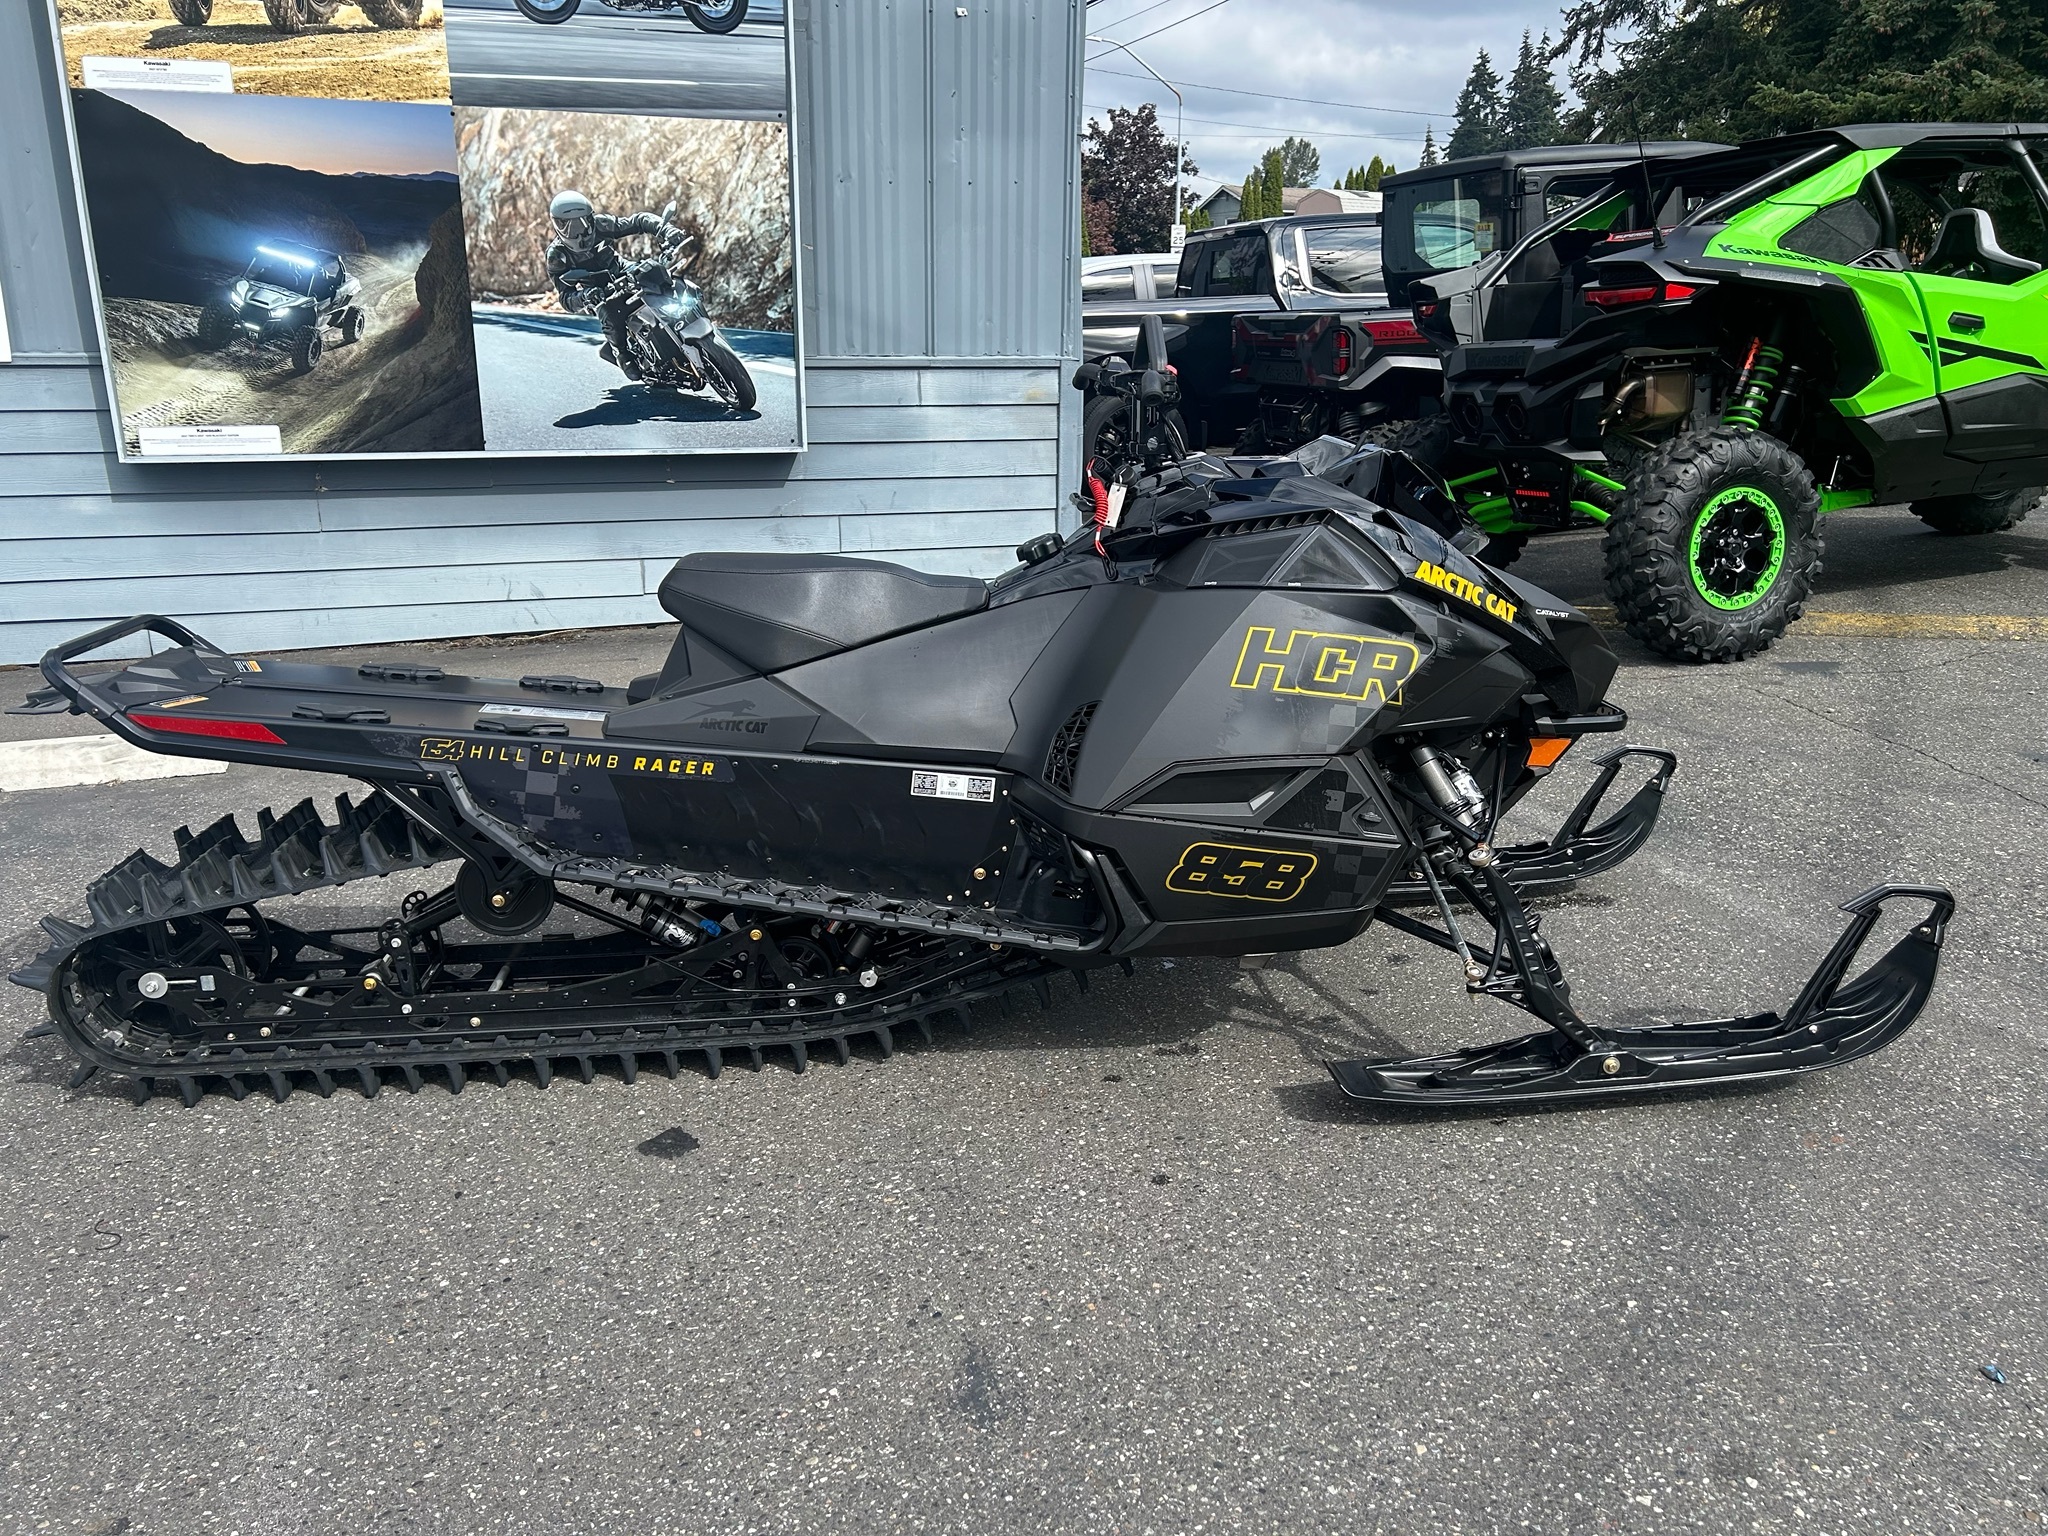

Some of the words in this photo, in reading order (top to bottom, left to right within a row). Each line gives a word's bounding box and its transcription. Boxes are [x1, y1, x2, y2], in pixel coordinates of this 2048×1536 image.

[1173, 236, 1184, 245] 25
[1717, 243, 1829, 267] Kawasaki
[1470, 351, 1525, 367] Kawasaki
[1414, 560, 1484, 607] ARCTIC
[1485, 593, 1518, 624] CAT
[1535, 608, 1570, 618] CATALYST
[1230, 626, 1420, 705] HCR
[699, 717, 744, 732] ARCTIC
[745, 721, 768, 734] CAT
[420, 738, 465, 761] 154
[469, 745, 525, 762] HILL
[541, 750, 619, 769] CLIMB
[633, 757, 715, 776] RACER
[1165, 841, 1318, 902] 858
